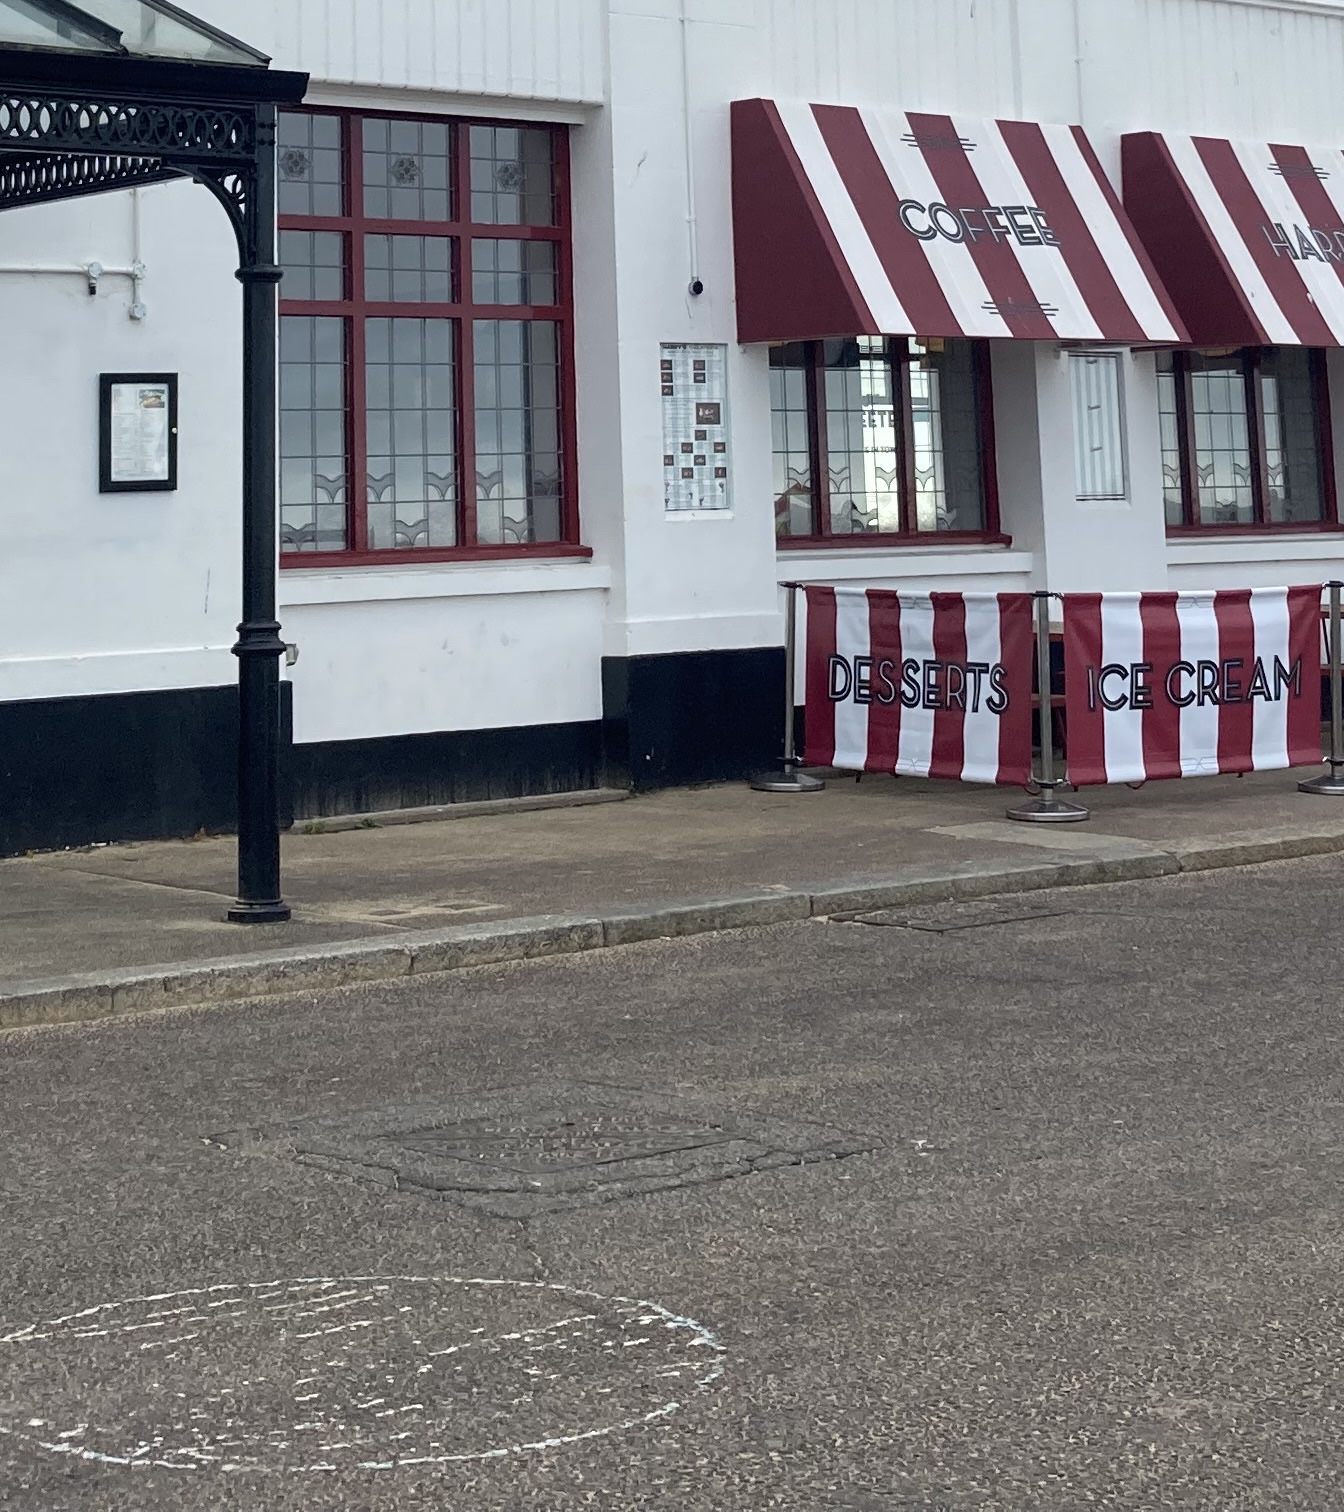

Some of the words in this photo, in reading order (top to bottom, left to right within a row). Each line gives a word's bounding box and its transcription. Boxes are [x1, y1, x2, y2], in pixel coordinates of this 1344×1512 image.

[898, 199, 1060, 247] COFFEE
[828, 653, 1010, 713] DESSERTS
[1087, 663, 1153, 711] ICE
[1165, 653, 1302, 708] CREAM
